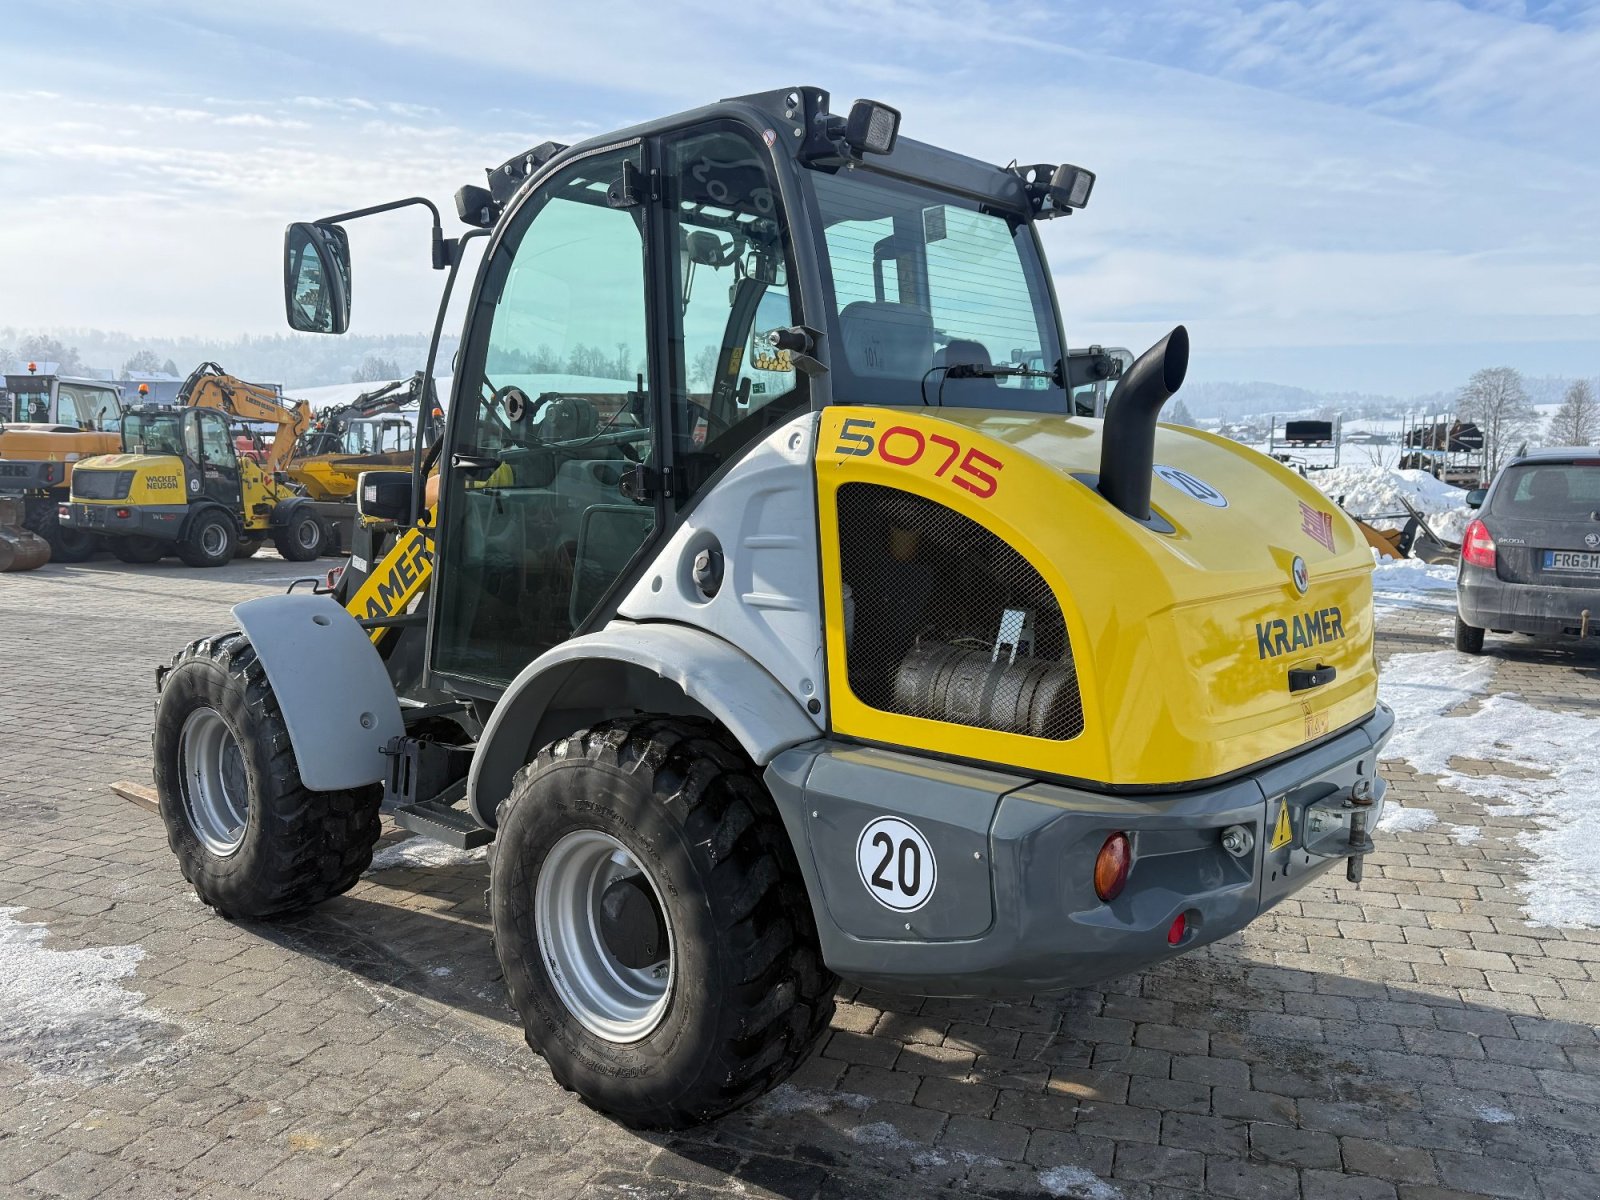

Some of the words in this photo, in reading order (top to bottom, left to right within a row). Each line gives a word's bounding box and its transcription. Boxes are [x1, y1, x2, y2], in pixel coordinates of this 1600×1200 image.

[834, 418, 1004, 499] 5075
[145, 475, 177, 483] WACKER
[146, 482, 179, 490] NEUSON
[1160, 470, 1219, 499] 20
[1553, 553, 1580, 568] FRG
[1255, 606, 1346, 660] KRAMER
[871, 831, 921, 897] 20
